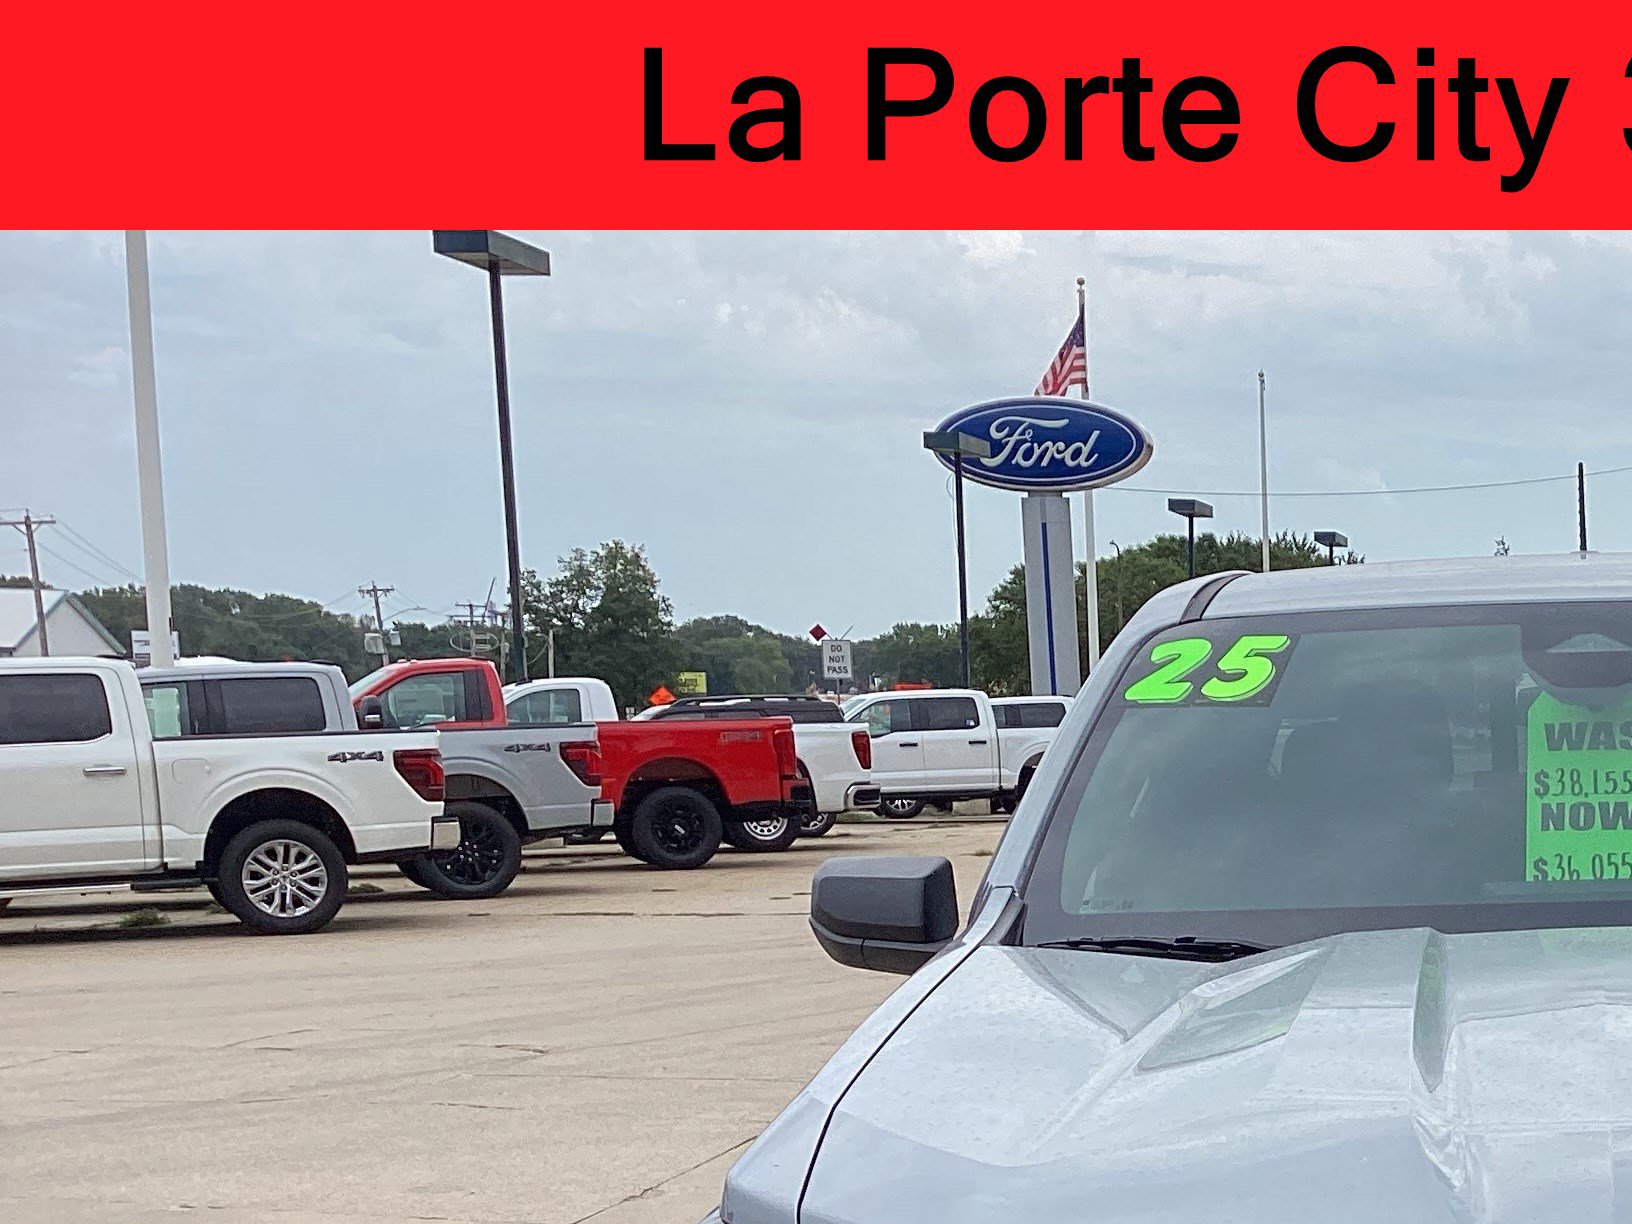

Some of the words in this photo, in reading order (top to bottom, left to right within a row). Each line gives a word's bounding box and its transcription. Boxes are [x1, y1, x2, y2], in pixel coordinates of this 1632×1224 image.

[980, 416, 1101, 468] Ford
[831, 644, 842, 652] DO
[829, 655, 845, 663] NOT
[827, 665, 849, 674] PASS
[1124, 635, 1287, 703] 25
